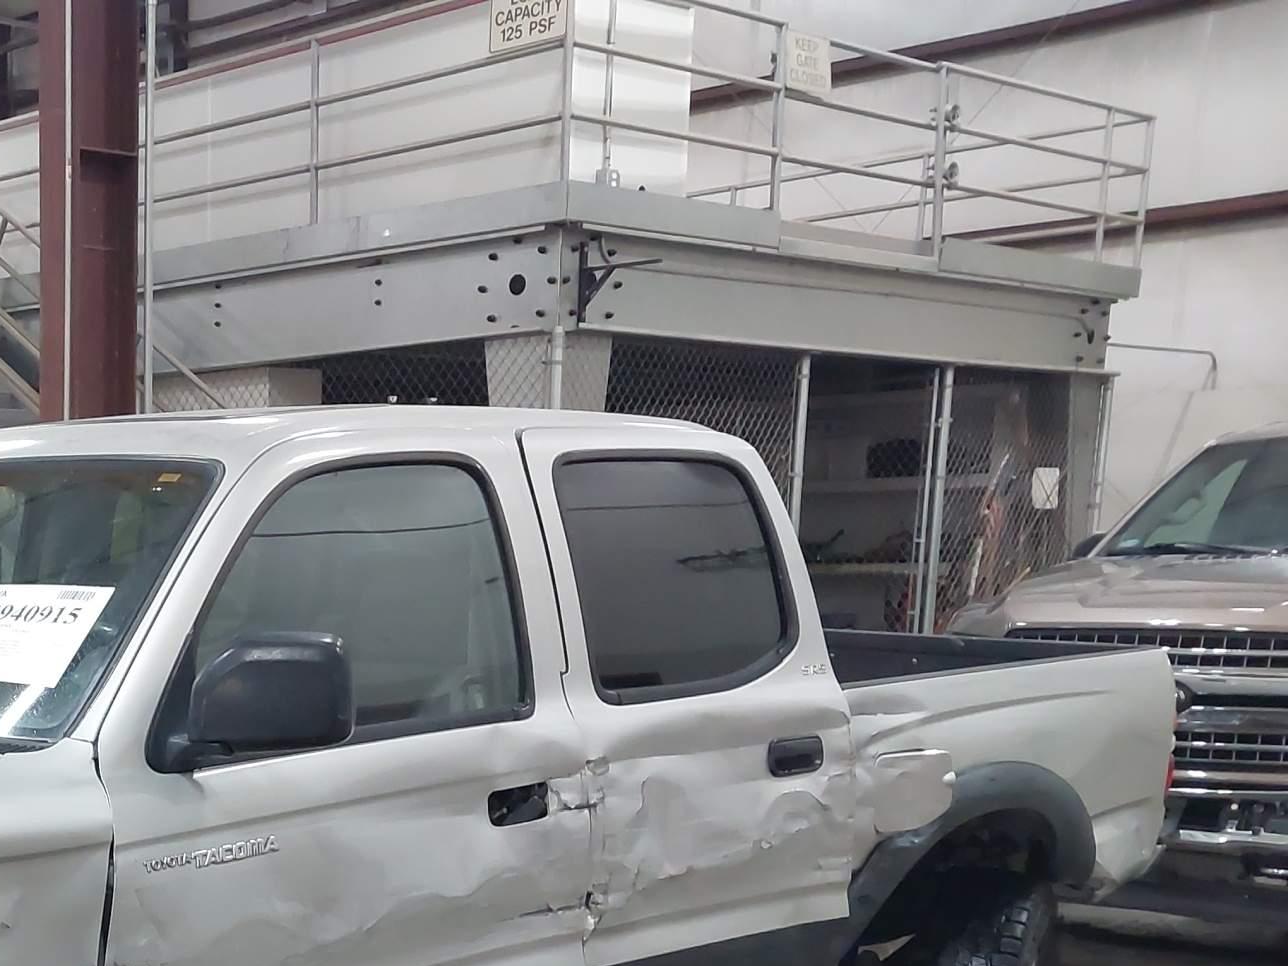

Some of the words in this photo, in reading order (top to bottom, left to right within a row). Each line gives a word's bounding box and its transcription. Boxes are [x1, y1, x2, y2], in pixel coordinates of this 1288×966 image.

[495, 0, 562, 26] CAPACITY
[500, 24, 523, 42] 125
[529, 15, 556, 36] PSF
[143, 852, 191, 873] TOYOTA
[192, 834, 279, 868] TACOMA
